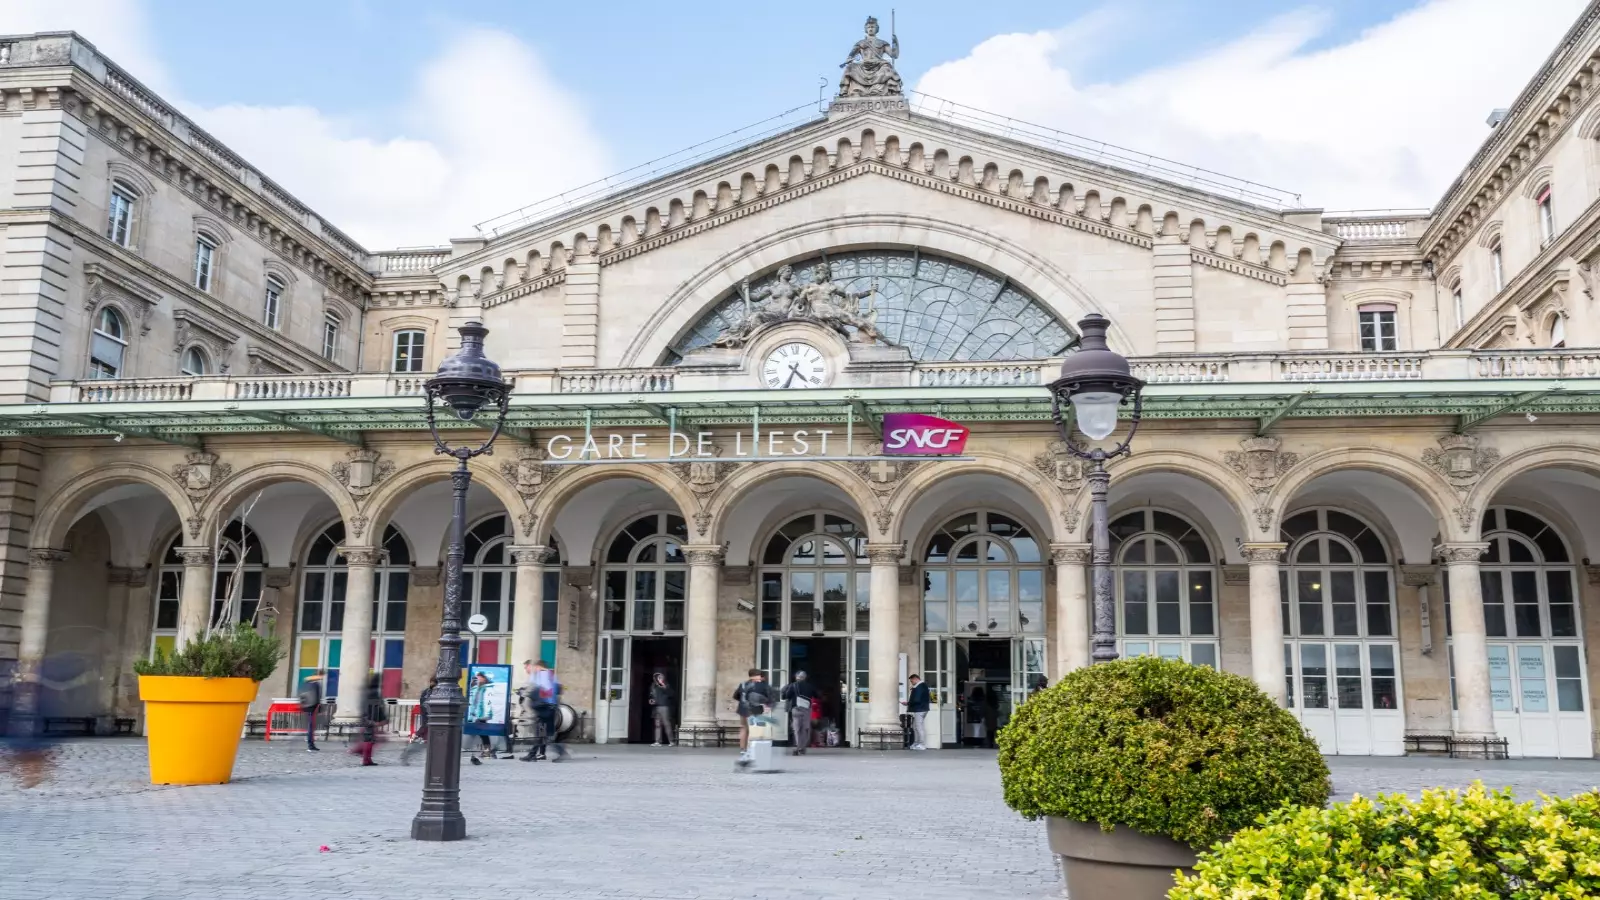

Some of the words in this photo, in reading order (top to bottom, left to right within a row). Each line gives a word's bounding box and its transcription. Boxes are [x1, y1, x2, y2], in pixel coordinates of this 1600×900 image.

[547, 434, 647, 459] GARE
[669, 431, 713, 457] DE
[886, 428, 964, 449] SNCF
